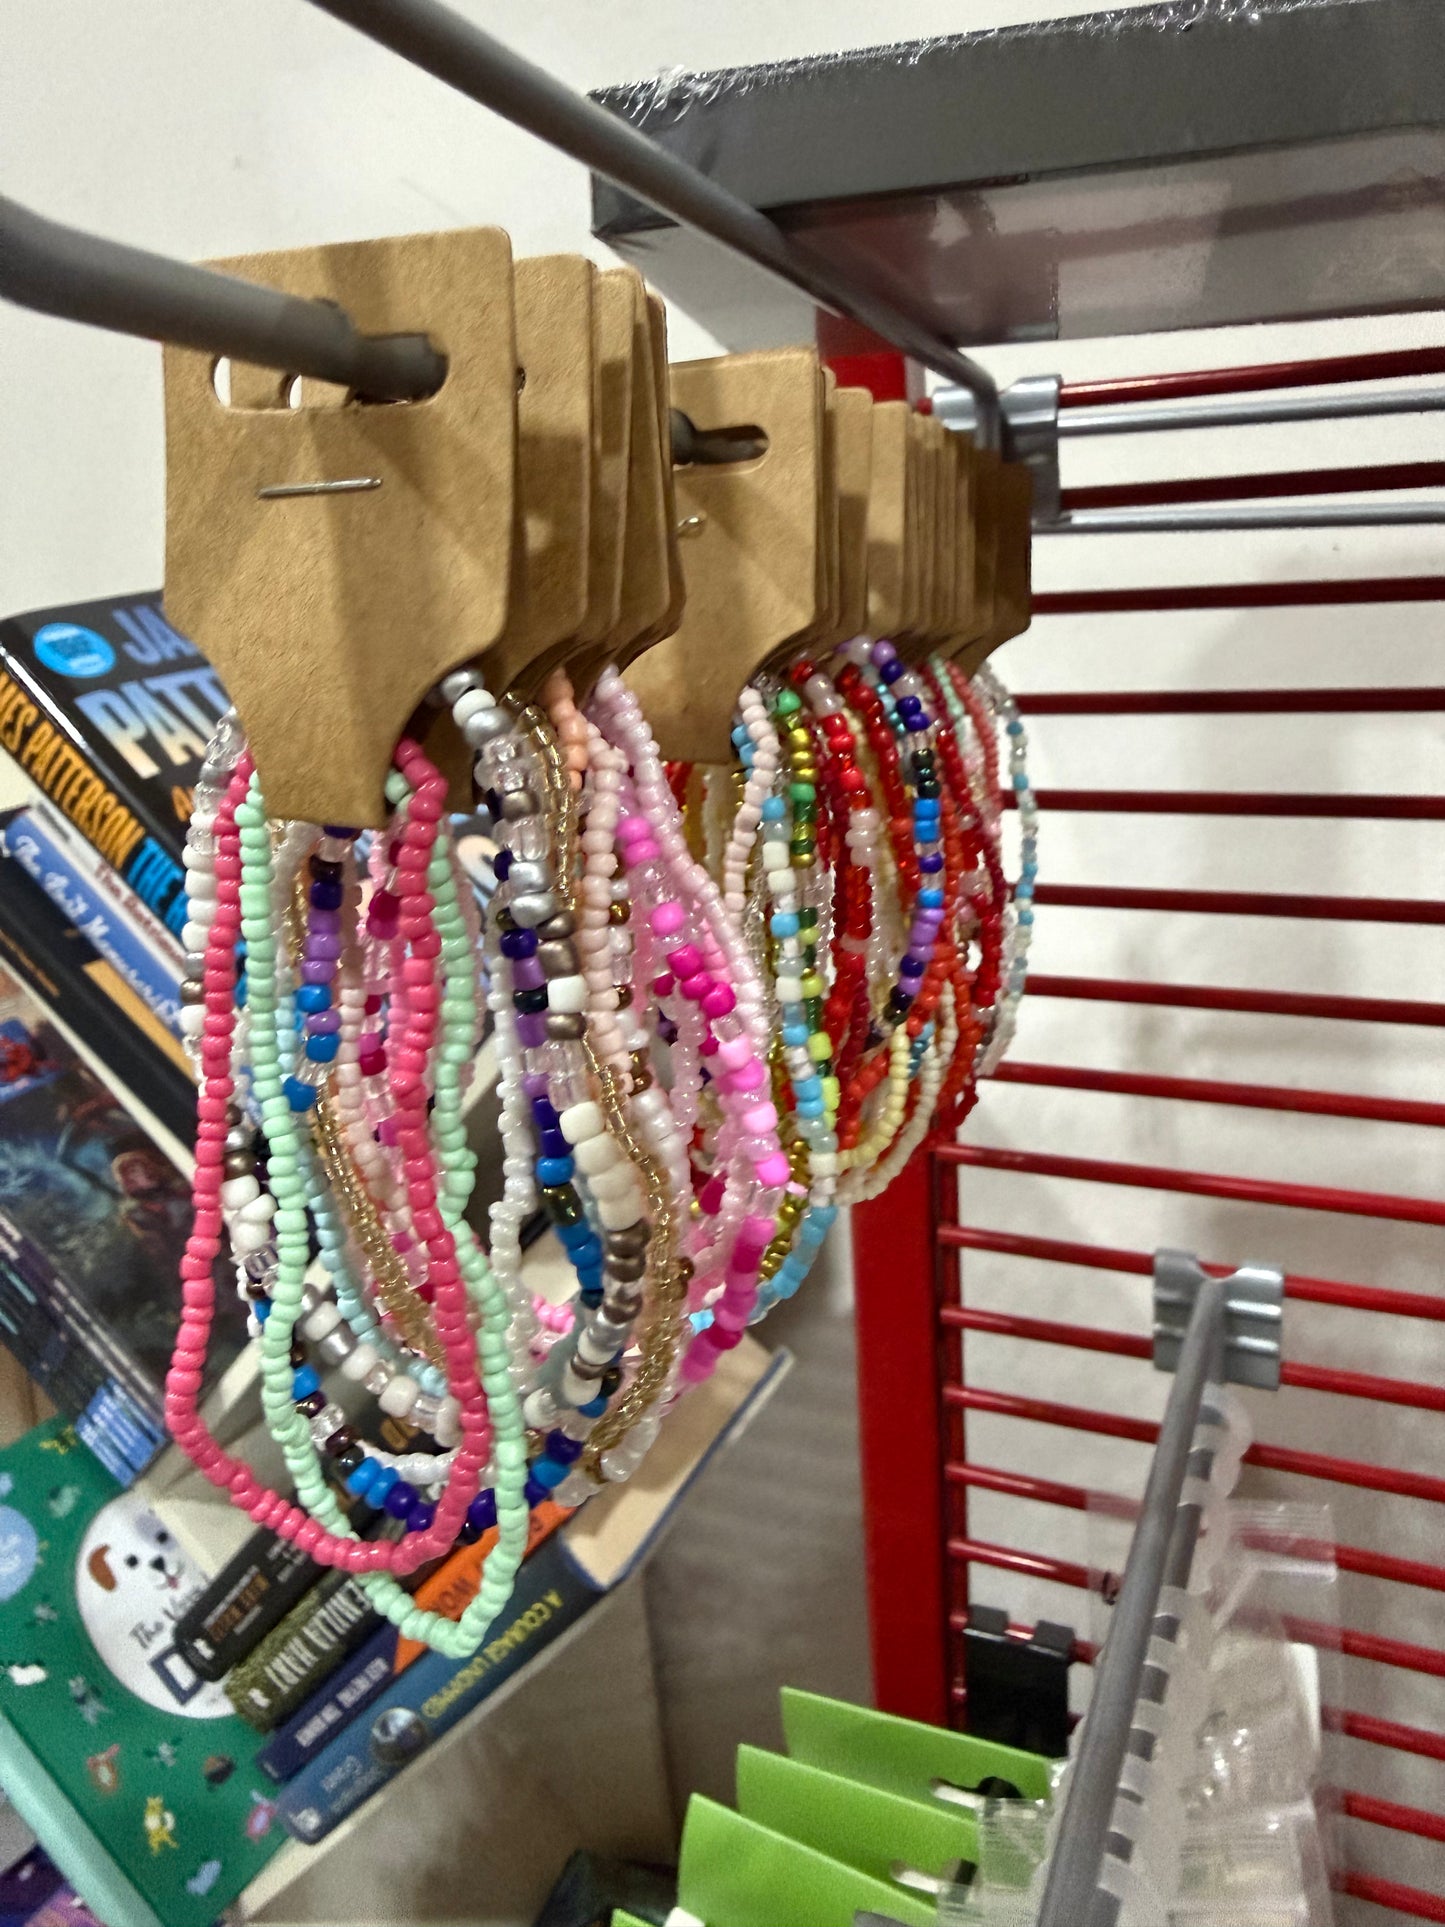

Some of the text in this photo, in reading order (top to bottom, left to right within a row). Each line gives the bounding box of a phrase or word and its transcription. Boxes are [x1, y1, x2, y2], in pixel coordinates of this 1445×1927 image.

[112, 605, 202, 666] JA
[73, 664, 234, 780] PATT
[21, 719, 146, 871] PATTERSON
[127, 836, 186, 915] THE
[14, 835, 41, 880] The
[301, 1579, 372, 1651] EMILIA
[543, 1589, 564, 1609] A
[482, 1602, 552, 1664] COURAGE
[264, 1635, 319, 1695] HART
